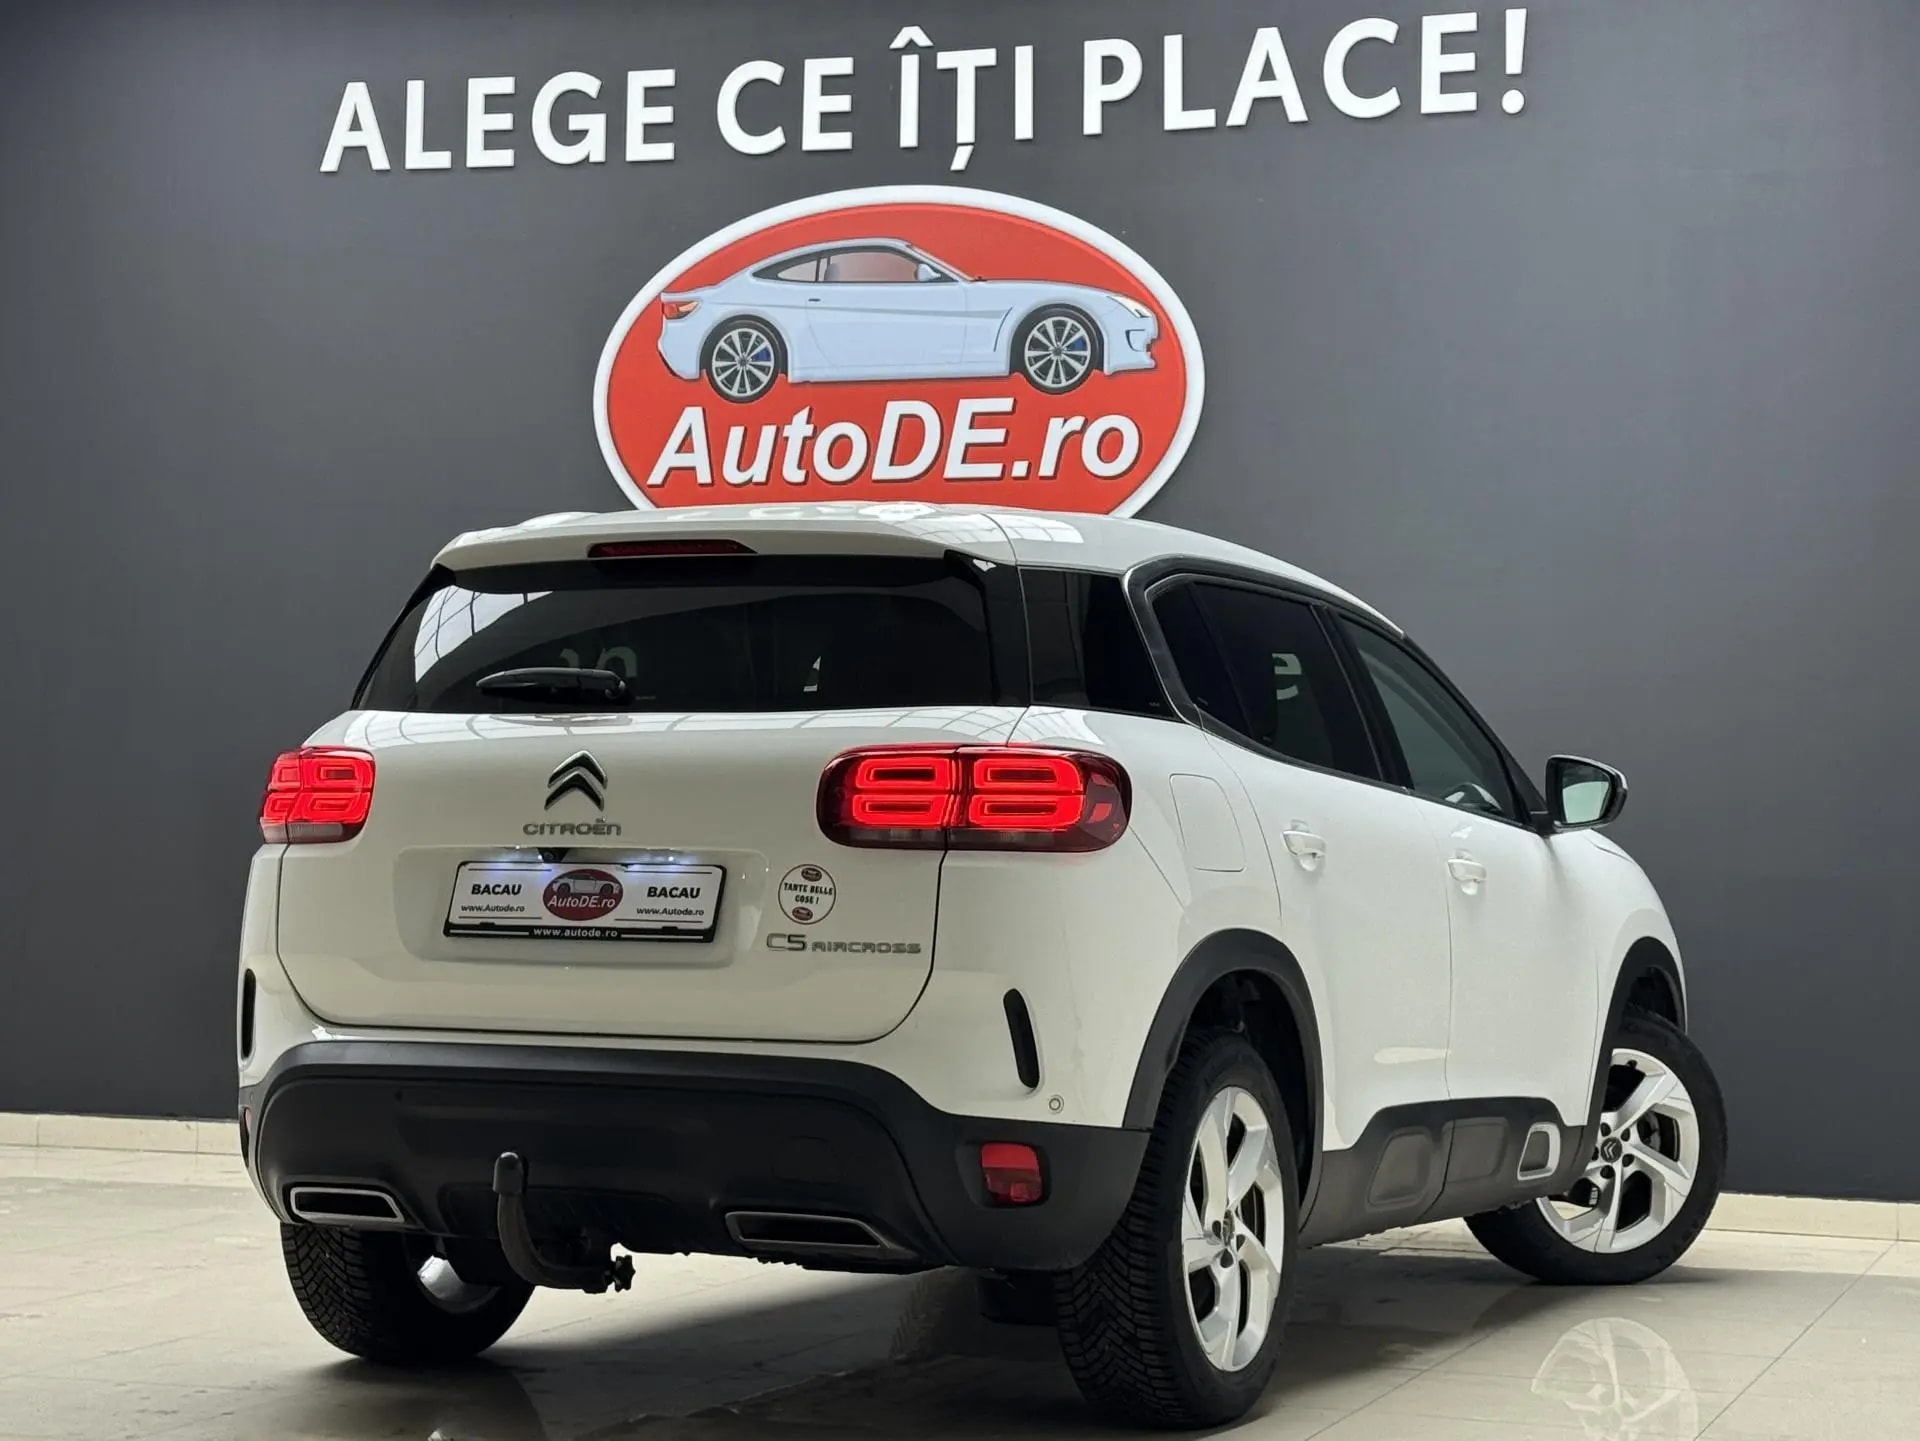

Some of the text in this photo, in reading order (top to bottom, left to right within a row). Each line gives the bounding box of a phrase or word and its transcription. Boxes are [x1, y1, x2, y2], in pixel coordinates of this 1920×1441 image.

[319, 68, 676, 173] ALEGE
[716, 56, 855, 155] CE
[1082, 7, 1528, 136] PLACE!
[646, 397, 1142, 488] AutoDE.ro
[523, 818, 622, 835] CITROËN
[471, 884, 522, 896] BACAU
[647, 887, 701, 899] BACAU
[810, 885, 833, 895] BELLE
[547, 895, 616, 909] AutoDE.ro
[461, 904, 525, 913] www.Autode.ro
[636, 907, 705, 916] www.Autode.ro
[533, 927, 619, 938] www.autode.ro
[767, 933, 921, 953] C5 AIRCROSS
